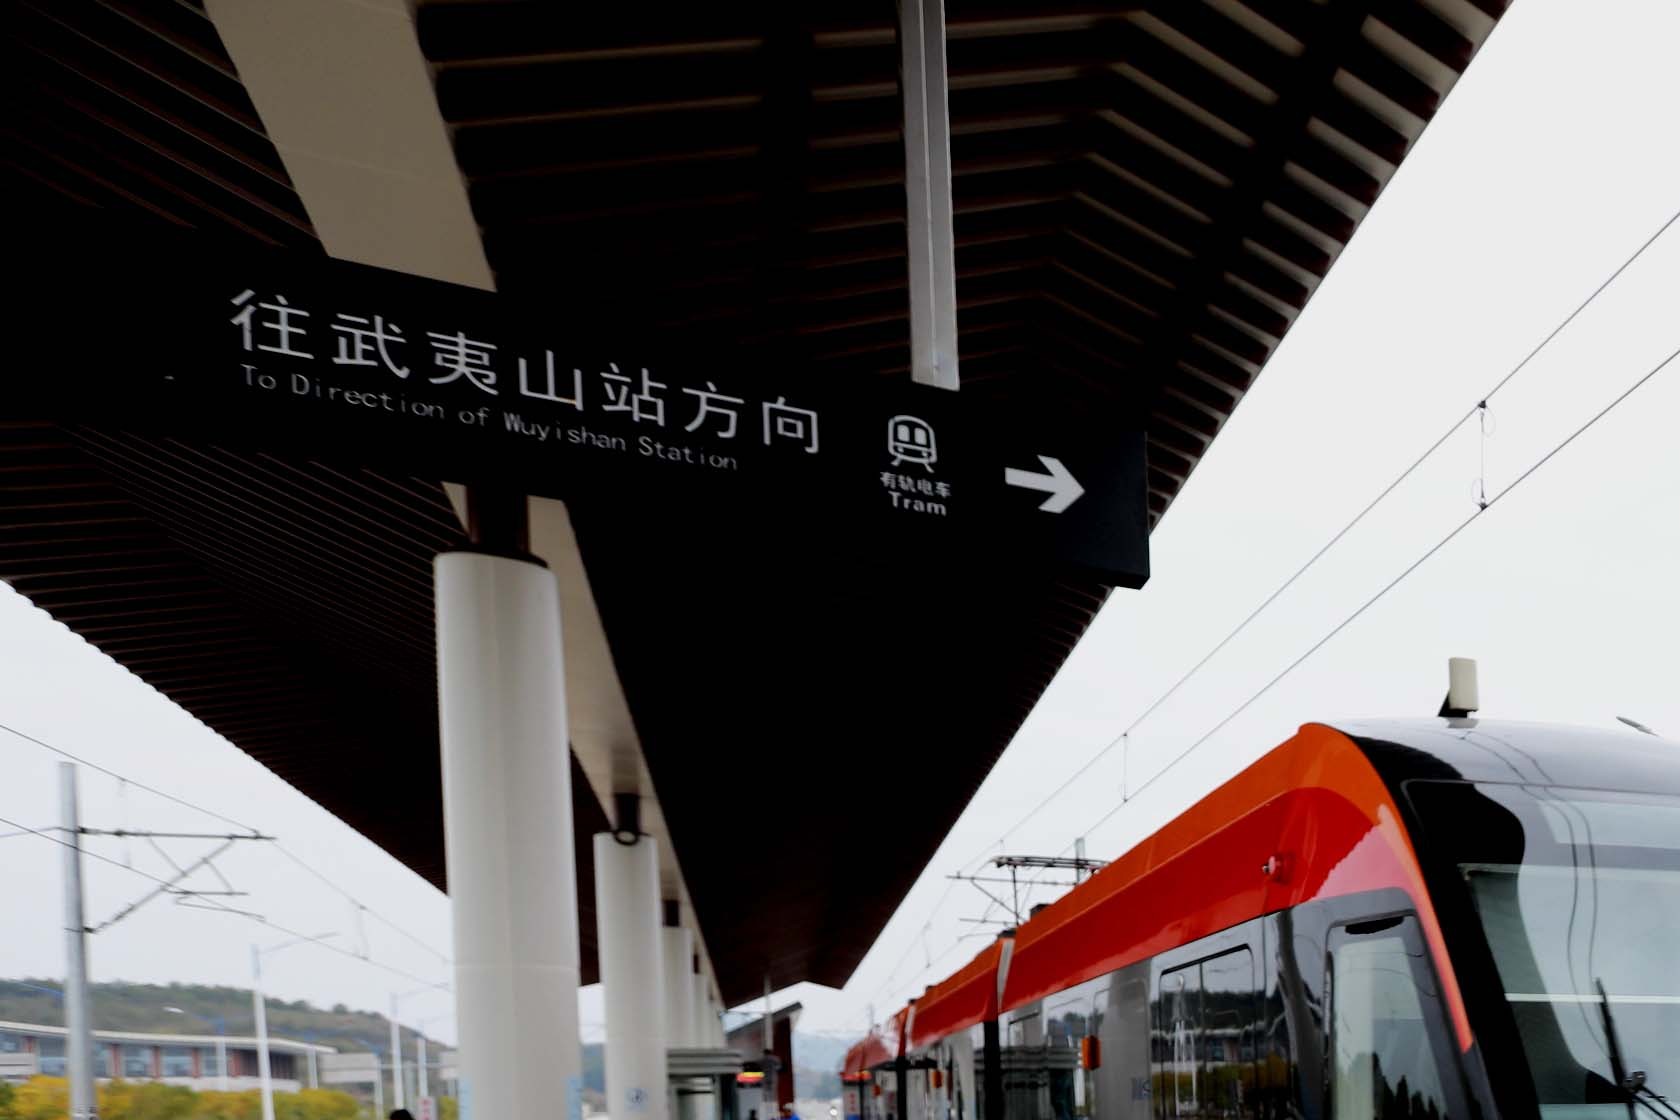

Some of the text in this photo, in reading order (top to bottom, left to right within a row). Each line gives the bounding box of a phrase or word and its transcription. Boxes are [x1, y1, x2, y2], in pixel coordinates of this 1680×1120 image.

[230, 288, 820, 455] 往武夷山站方向
[240, 363, 738, 471] To Direction of Wuyishan Station
[879, 470, 952, 498] 有轨电车
[887, 490, 948, 516] Tram
